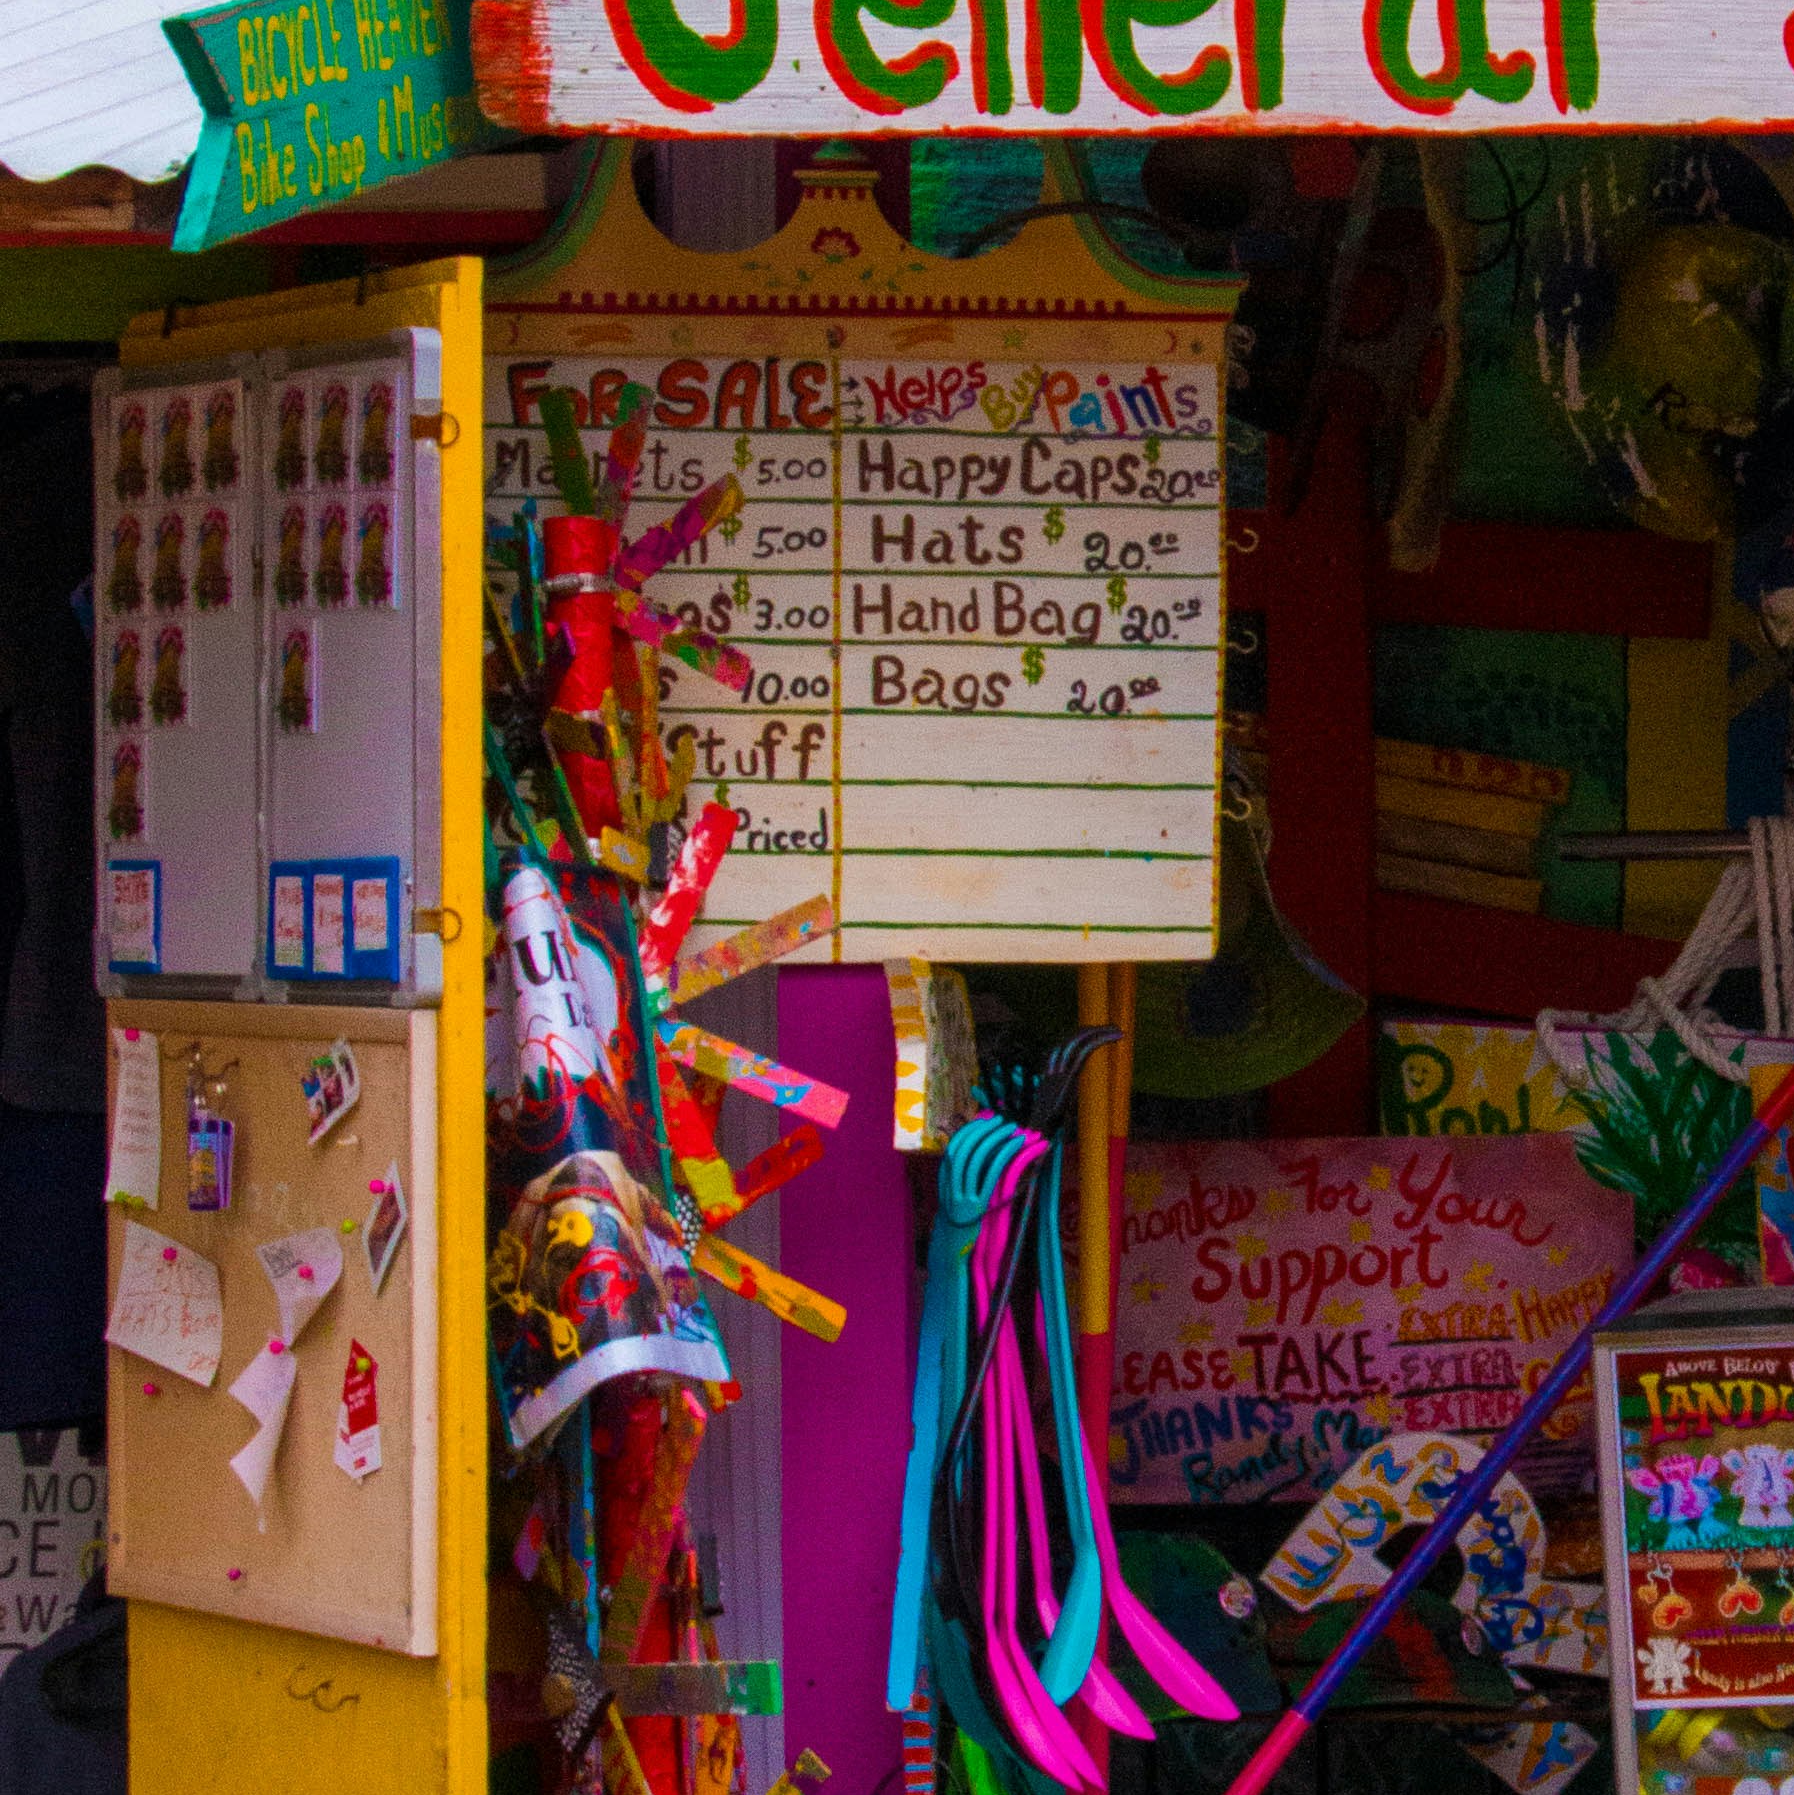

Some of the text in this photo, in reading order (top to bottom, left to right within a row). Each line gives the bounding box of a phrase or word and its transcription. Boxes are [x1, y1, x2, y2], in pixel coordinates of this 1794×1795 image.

[235, 118, 297, 215] Bike
[304, 102, 367, 196] Shop
[651, 358, 838, 430] SALE
[1043, 365, 1199, 436] Paints
[1020, 436, 1141, 501] Caps
[870, 513, 1026, 566] Hats
[871, 654, 1012, 713] Bags
